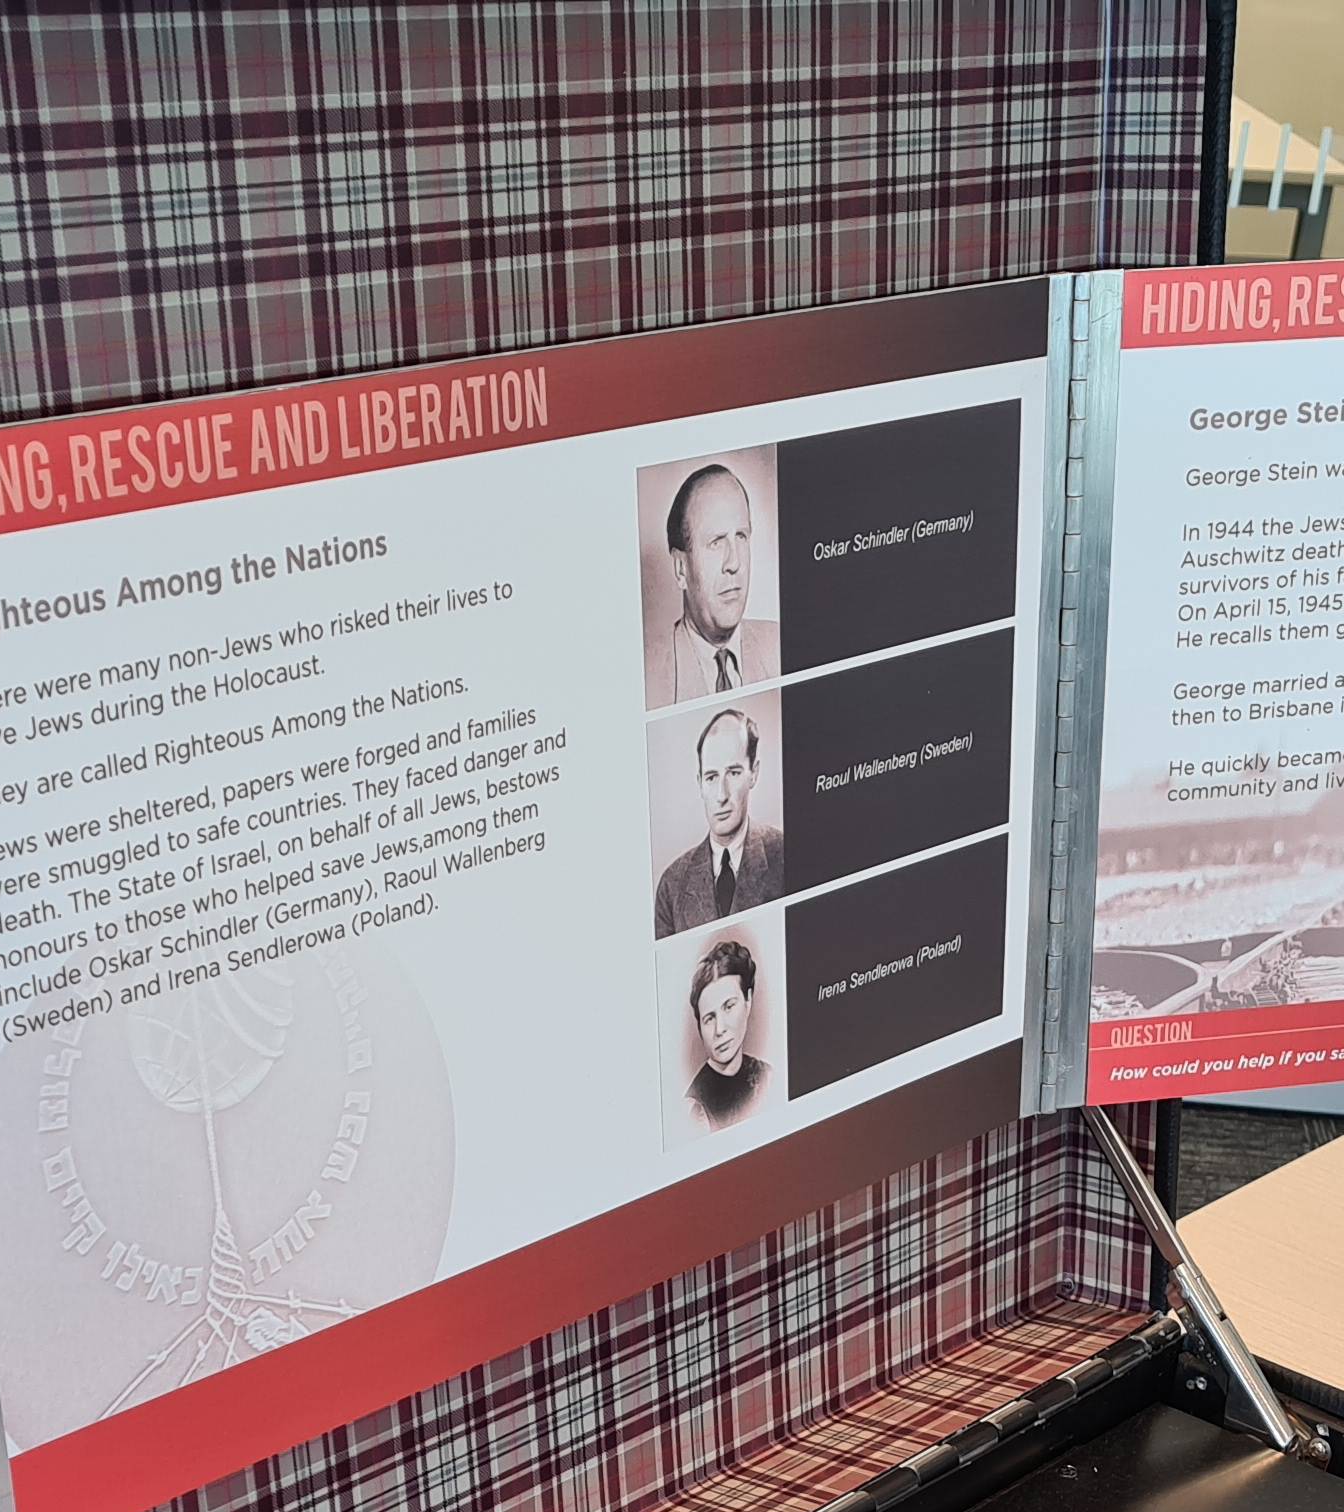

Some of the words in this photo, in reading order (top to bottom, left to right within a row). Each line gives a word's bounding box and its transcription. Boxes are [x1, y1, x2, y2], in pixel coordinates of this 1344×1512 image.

[1142, 277, 1281, 335] HIDING,
[68, 412, 238, 503] RESCUE
[250, 400, 330, 475] AND
[337, 366, 548, 460] LIBERATION
[1189, 407, 1288, 432] George
[1185, 468, 1261, 487] George
[1267, 460, 1318, 482] Stein
[813, 539, 851, 561] Oskar
[852, 525, 911, 552] Schindler
[911, 509, 974, 544] (Germany)
[116, 565, 223, 608] Among
[230, 553, 277, 585] the
[285, 535, 388, 575] Nations
[33, 672, 92, 700] were
[98, 656, 161, 687] many
[168, 633, 273, 672] non-Jews
[278, 620, 324, 648] who
[330, 602, 390, 637] risked
[395, 593, 441, 623] their
[446, 587, 488, 612] lives
[493, 581, 513, 601] to
[815, 766, 851, 794] Raoul
[853, 751, 918, 782] Wallenberg
[920, 731, 973, 766] (Sweden)
[817, 980, 847, 1002] Irena
[849, 954, 914, 989] Sendlerowa
[916, 934, 962, 968] (Poland)
[1110, 1020, 1193, 1048] QUESTION
[1110, 1067, 1147, 1081] How
[1152, 1060, 1199, 1077] could
[1203, 1060, 1234, 1075] you
[1237, 1052, 1274, 1070] help
[1279, 1050, 1293, 1065] if
[1296, 1051, 1325, 1066] you
